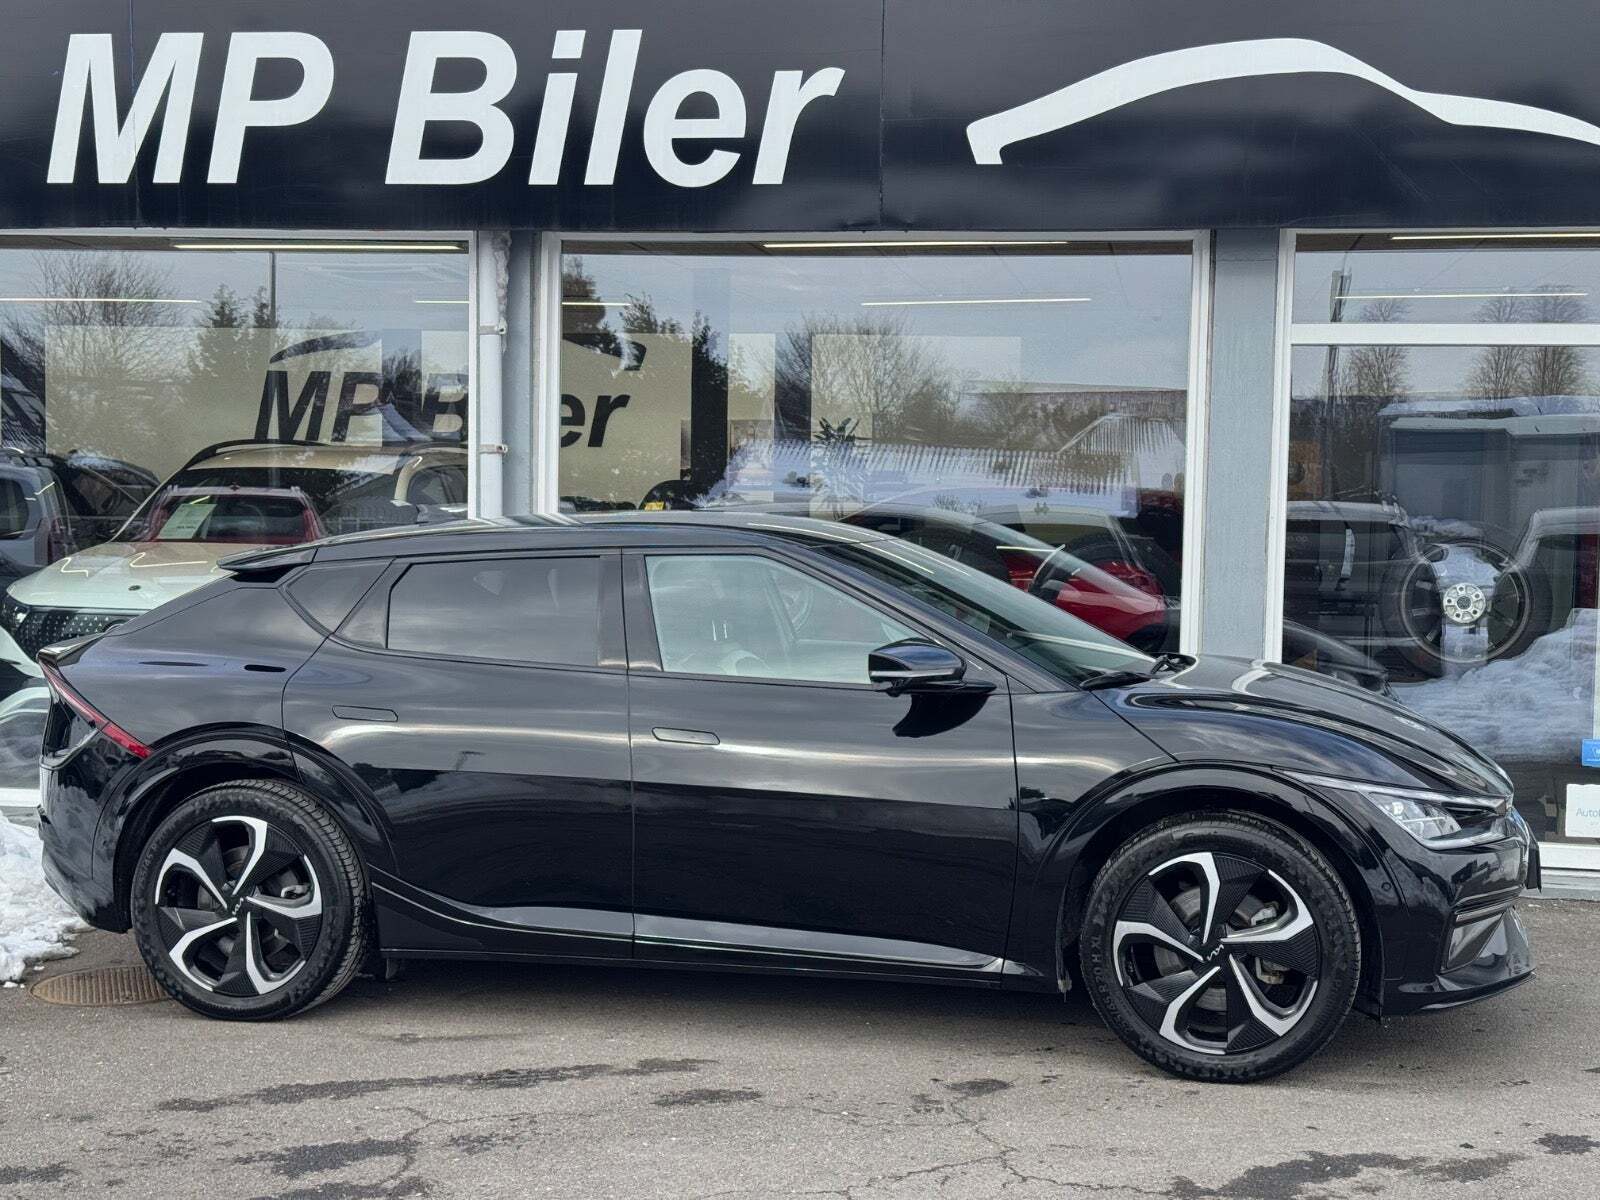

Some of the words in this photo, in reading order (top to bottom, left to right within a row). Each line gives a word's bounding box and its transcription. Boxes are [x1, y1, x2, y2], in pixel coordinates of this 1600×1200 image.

[47, 31, 335, 185] MP
[386, 29, 846, 188] Biler
[254, 370, 390, 442] MP
